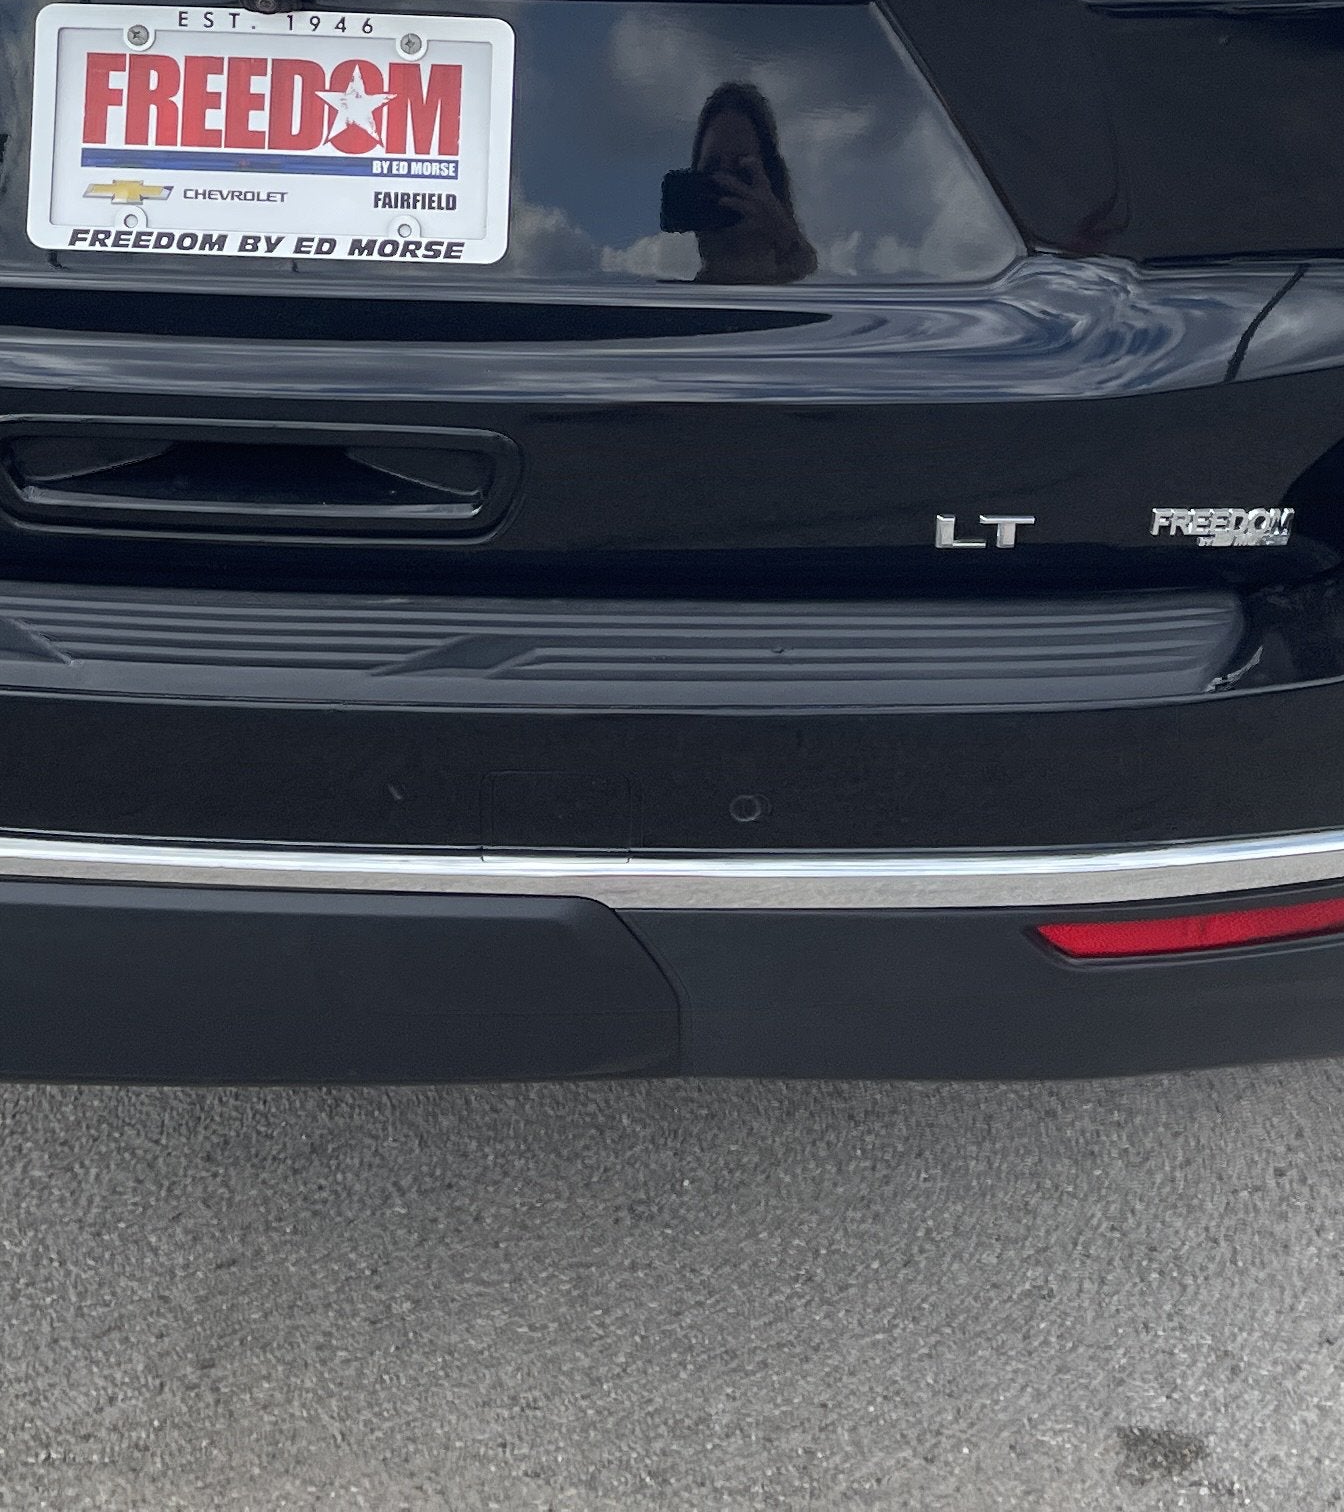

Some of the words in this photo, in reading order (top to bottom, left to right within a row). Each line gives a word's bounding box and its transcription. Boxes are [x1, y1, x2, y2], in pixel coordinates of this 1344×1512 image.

[178, 11, 256, 29] EST.
[286, 14, 374, 34] 1946
[82, 52, 463, 156] FREEDOM
[372, 160, 390, 174] BY
[391, 161, 408, 175] ED
[410, 161, 456, 177] MORSE
[183, 188, 289, 203] CHEVROLET
[373, 191, 457, 211] FAIRFIELD
[68, 228, 229, 252] FREEDOM
[237, 235, 286, 254] BY
[293, 236, 337, 256] ED
[347, 238, 465, 260] MORSE
[935, 513, 1036, 549] LT
[1151, 508, 1296, 536] FREEDOM
